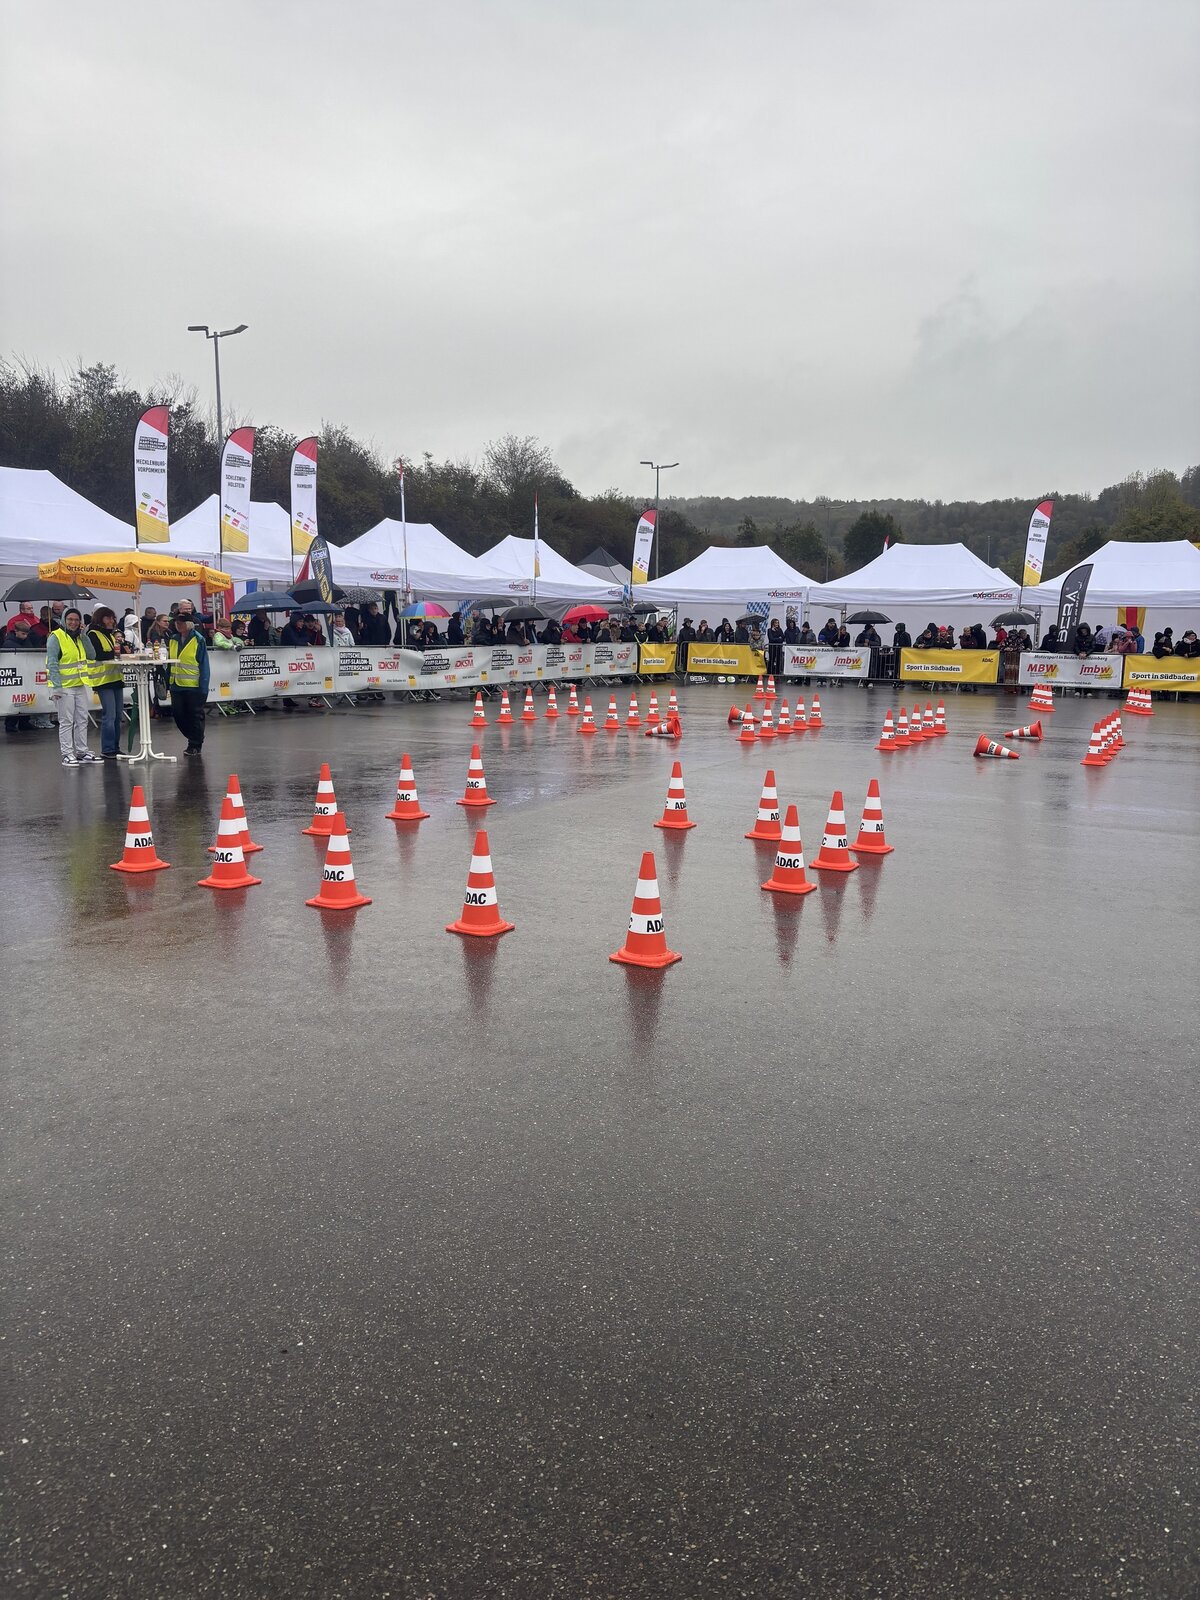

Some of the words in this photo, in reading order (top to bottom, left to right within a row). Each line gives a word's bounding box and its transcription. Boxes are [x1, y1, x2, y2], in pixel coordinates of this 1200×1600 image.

[136, 459, 166, 467] MECKLENBURG-
[137, 466, 166, 474] VORPOMMERN
[225, 474, 247, 482] SCHLESWIG-
[66, 565, 94, 573] Ortsclub
[138, 568, 167, 576] Ortsclub
[168, 569, 177, 577] im
[178, 570, 197, 578] ADAC
[768, 590, 802, 598] expotrade
[973, 592, 1013, 600] expotrade
[1056, 591, 1079, 643] BERA
[791, 656, 816, 664] MBW
[834, 656, 861, 665] jmbw
[240, 661, 275, 669] KART-SLALOM-
[930, 665, 961, 673] Südbaden
[1027, 664, 1057, 672] MBW
[239, 668, 280, 676] MEISTERSCHAFT
[1080, 664, 1110, 675] jmbw
[1131, 672, 1150, 680] Sport
[1159, 674, 1195, 682] Südbaden
[0, 677, 22, 686] HAFT
[273, 680, 289, 688] MBW
[12, 693, 36, 703] MBW
[322, 870, 345, 881] DAC
